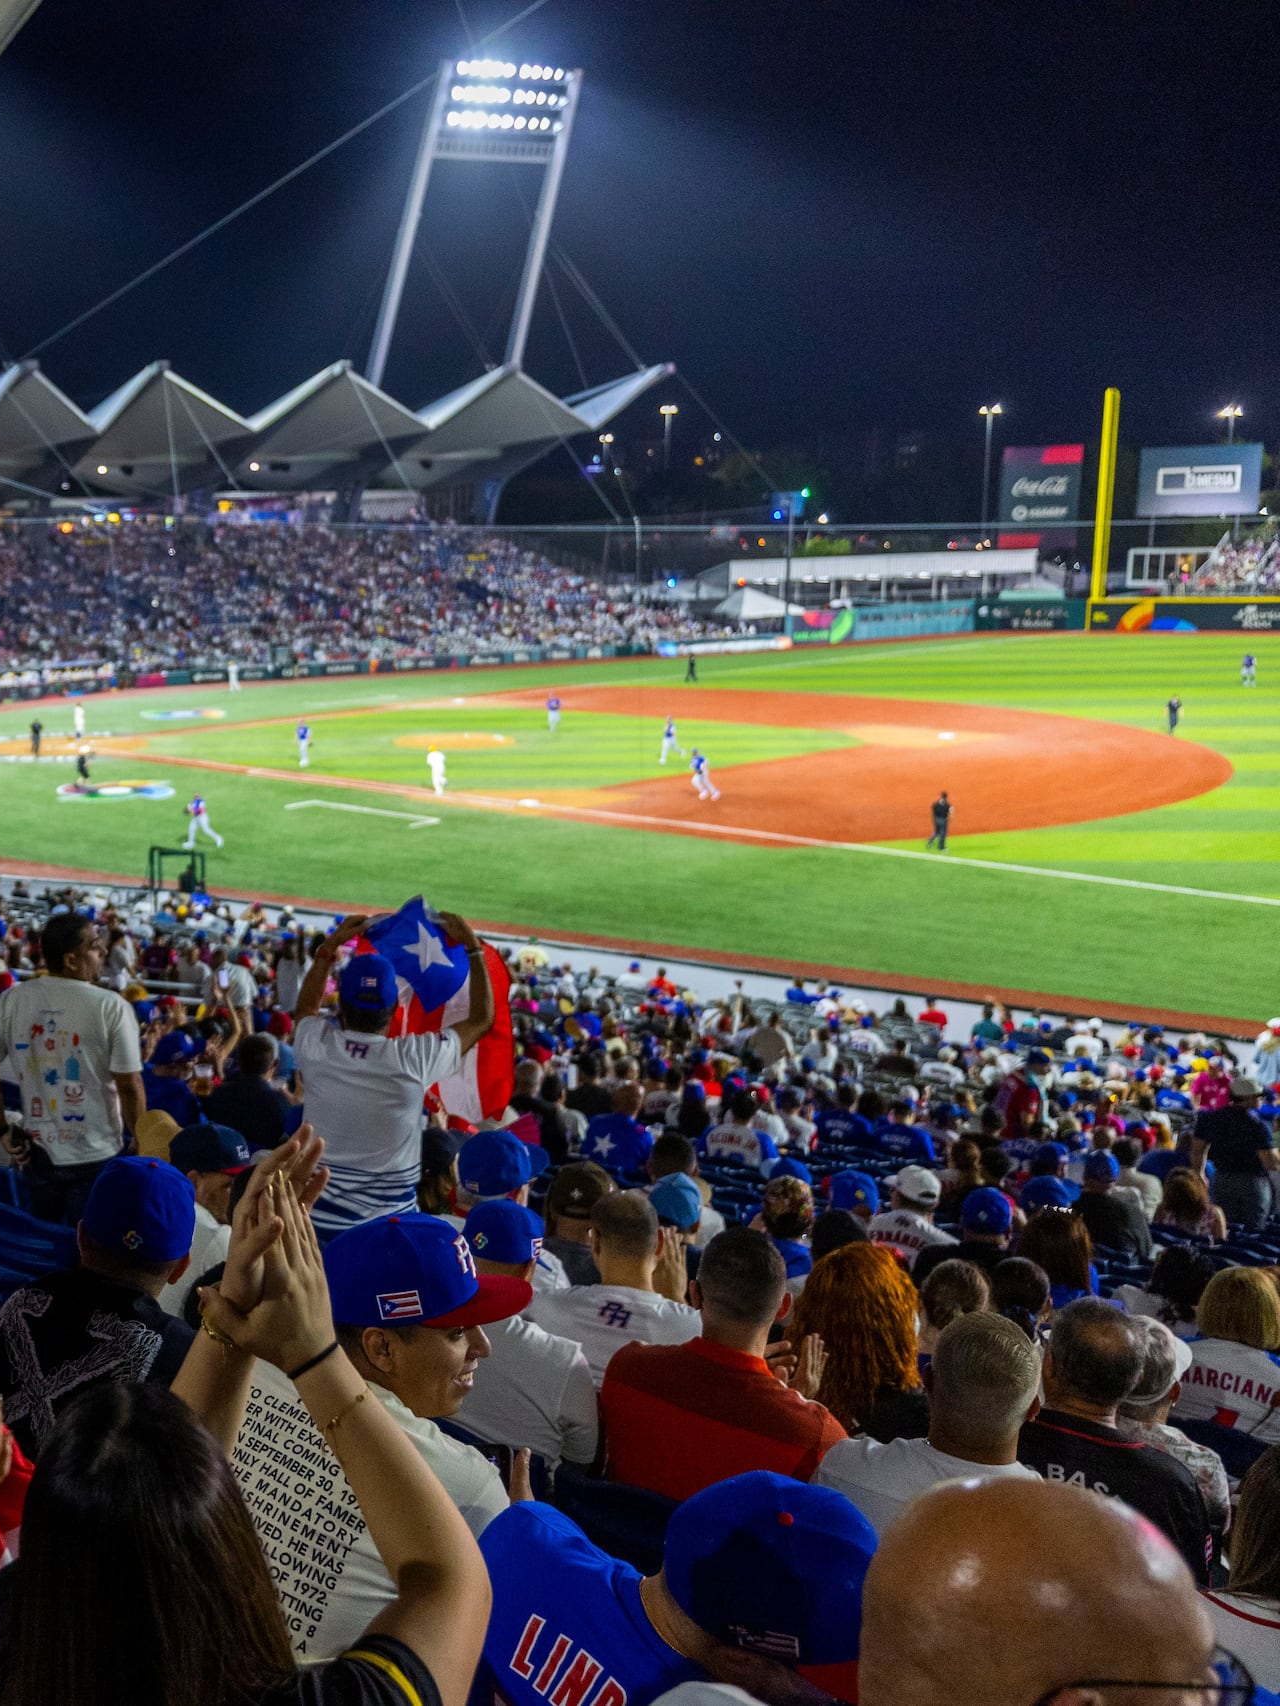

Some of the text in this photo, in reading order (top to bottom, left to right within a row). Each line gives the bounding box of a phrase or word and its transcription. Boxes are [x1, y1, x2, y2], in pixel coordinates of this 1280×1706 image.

[246, 1400, 334, 1457] ER WITH EXAC
[264, 1395, 321, 1432] CLEMEN
[242, 1417, 341, 1477] FINAL COMING
[245, 1436, 315, 1482] SEPTEMBER
[315, 1475, 334, 1496] 30,
[340, 1489, 360, 1510] 19
[242, 1488, 352, 1558] SHRINEMENT
[255, 1478, 359, 1546] MANDATORY
[259, 1462, 290, 1488] HALL
[294, 1483, 315, 1499] OF
[315, 1494, 366, 1534] FAMER
[251, 1512, 345, 1575] IVED. HE WAS
[259, 1537, 337, 1590] LLOWING
[269, 1566, 328, 1606] OF 1972.
[280, 1590, 324, 1622] TTING
[295, 1639, 306, 1654] A
[306, 1625, 317, 1638] 8
